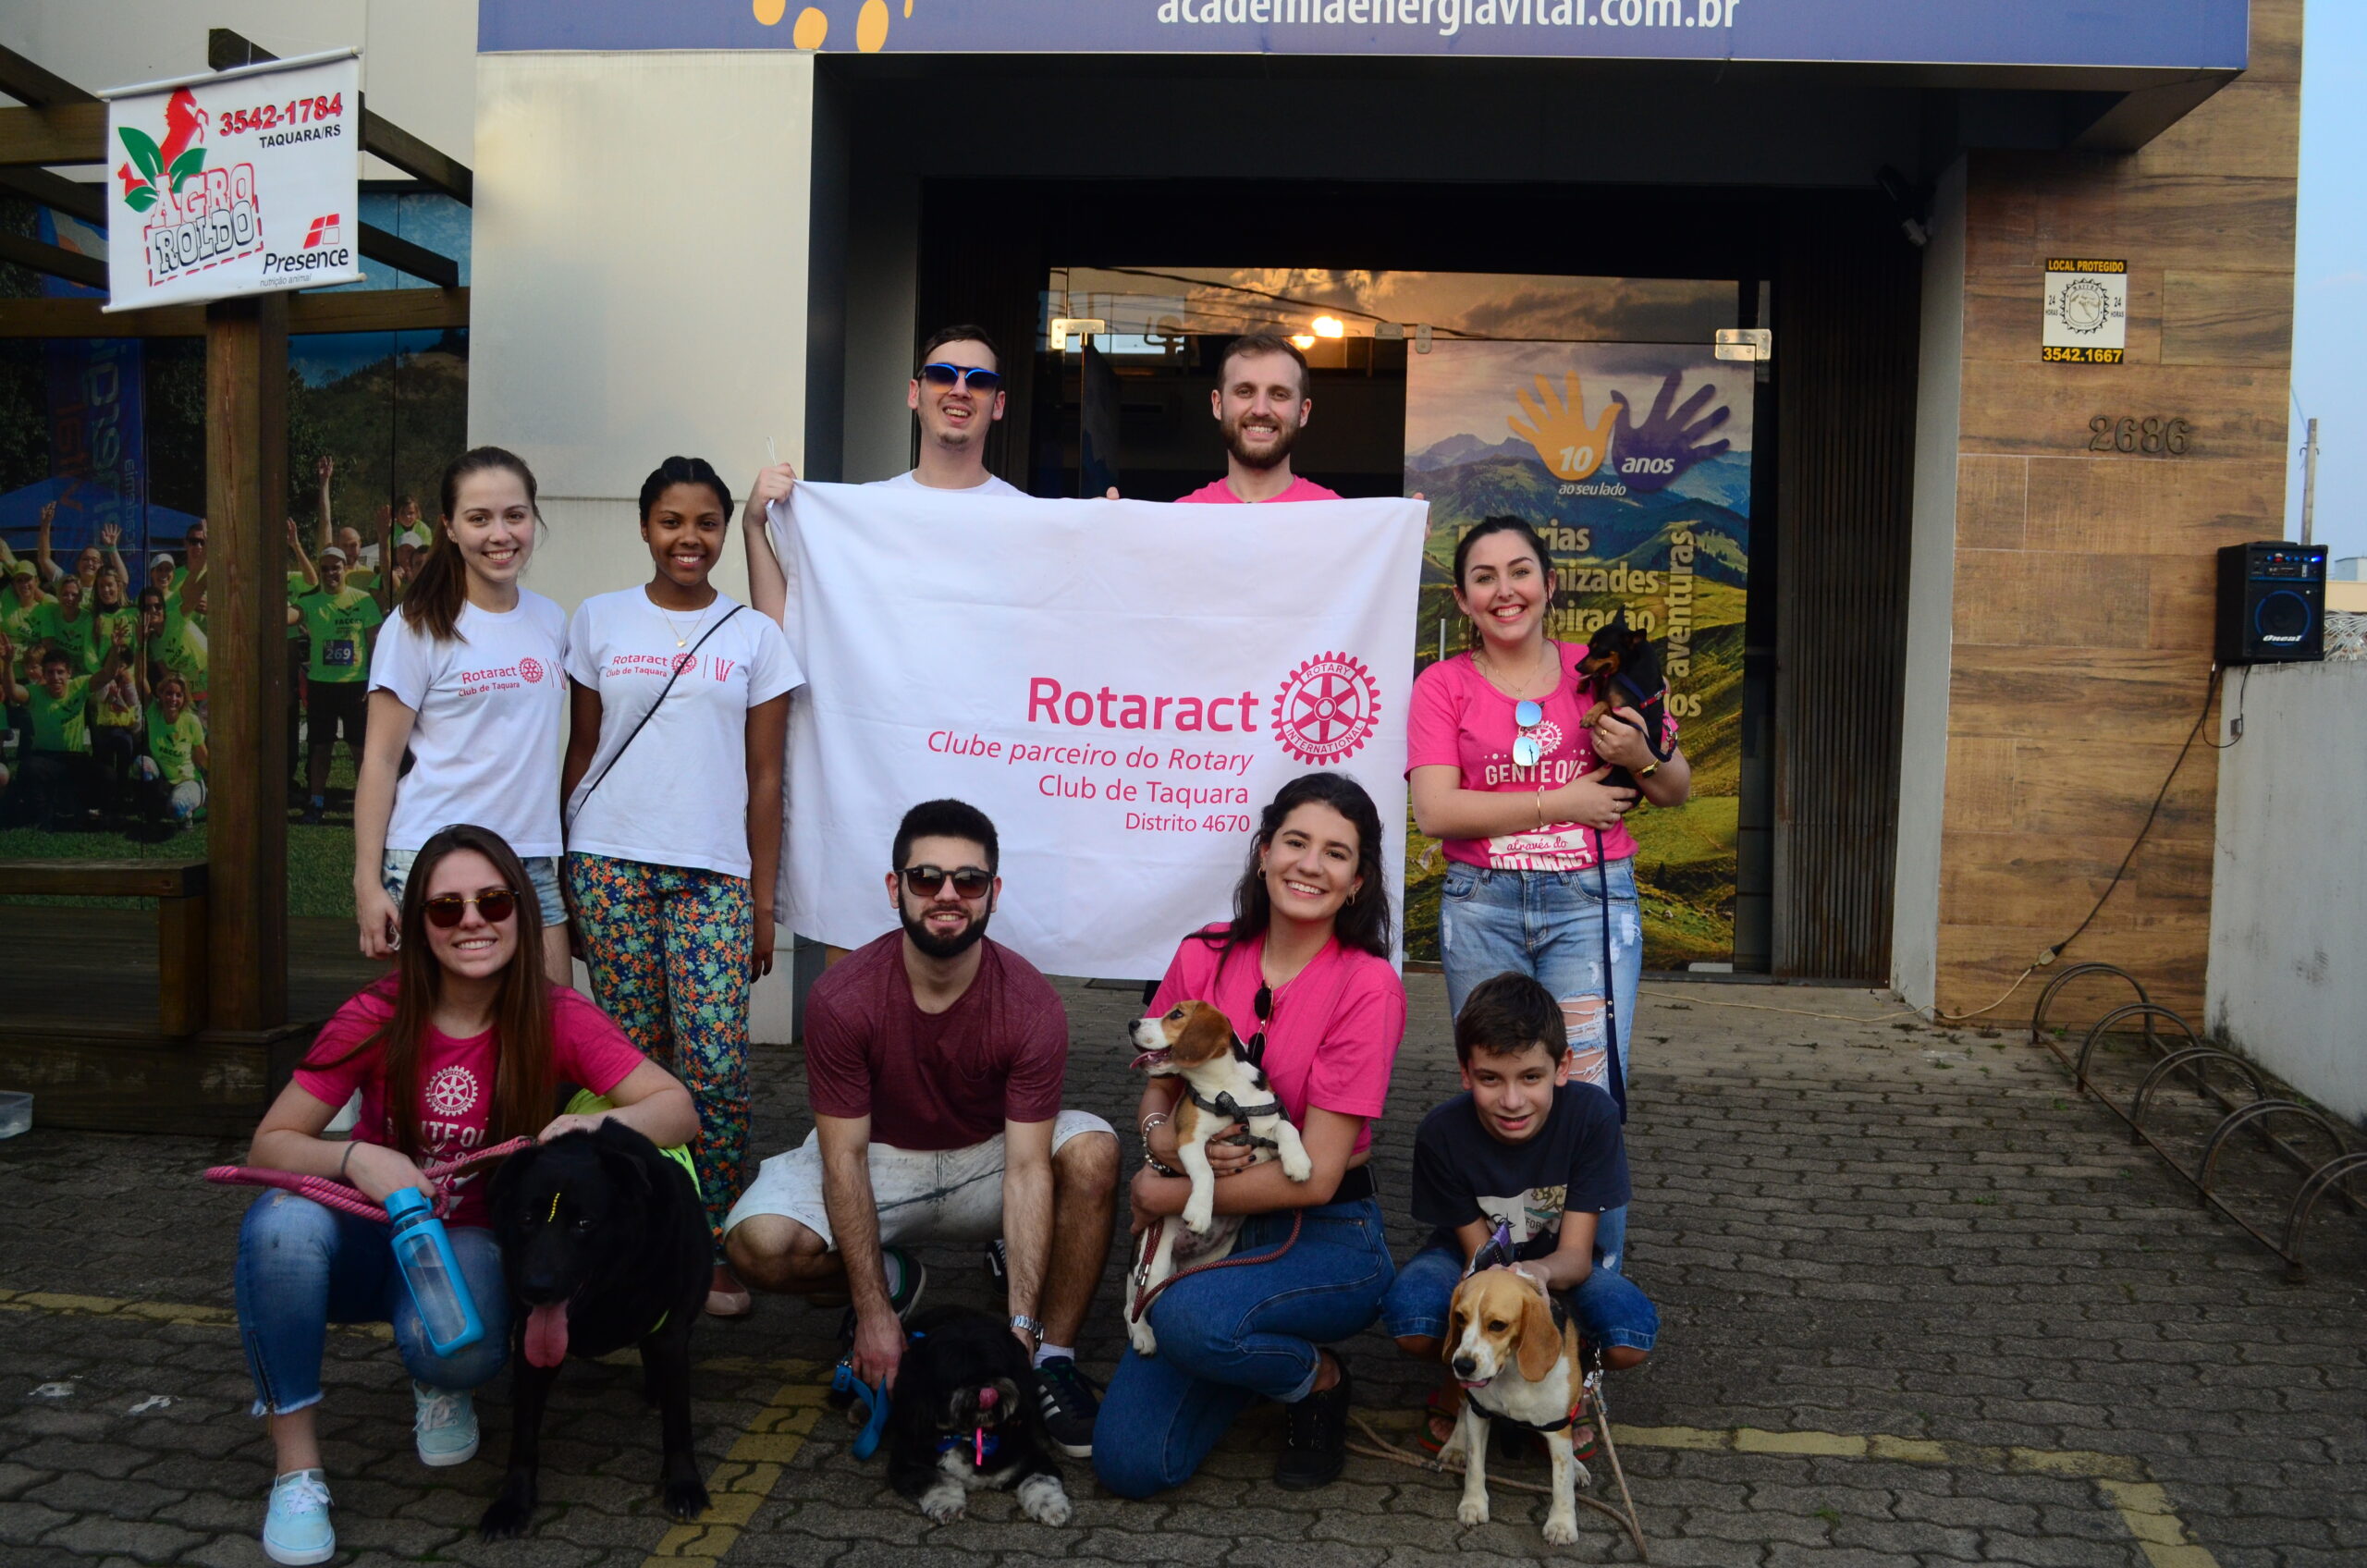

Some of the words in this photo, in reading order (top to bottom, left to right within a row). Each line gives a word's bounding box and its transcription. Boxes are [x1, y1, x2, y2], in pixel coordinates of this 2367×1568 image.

[219, 92, 343, 136] 3542-1784
[259, 124, 341, 149] TAQUARA/RS
[151, 163, 255, 229] AGRO
[154, 200, 254, 275] ROLDO
[263, 248, 349, 275] Presence
[2048, 260, 2075, 271] LOCAL
[2077, 260, 2124, 273] PROTEGIDO
[2048, 294, 2055, 305] 24
[2114, 297, 2122, 307] 24
[2043, 347, 2123, 362] 3542.1667
[2089, 415, 2190, 455] 2686
[1559, 446, 1593, 472] 10
[1621, 457, 1675, 474] anos
[1558, 484, 1574, 496] ao
[1575, 484, 1598, 496] seu
[1599, 482, 1626, 496] lado
[1665, 530, 1695, 678] aventuras
[325, 648, 351, 660] 269
[612, 654, 668, 667] Rotaract
[461, 666, 518, 684] Rotaract
[606, 668, 620, 678] Club
[622, 667, 632, 675] de
[634, 666, 668, 678] Taquara
[1306, 664, 1351, 679] ROTARY
[458, 687, 477, 697] Club
[479, 684, 490, 692] de
[492, 682, 521, 692] Taquara
[1026, 677, 1259, 733] Rotaract
[1286, 725, 1364, 753] INTERNATIONAL
[927, 730, 1001, 758] Clube
[1008, 740, 1117, 769] parceiro
[1125, 746, 1160, 769] do
[1167, 748, 1255, 778] Rotary
[1485, 760, 1553, 786] GENTE
[1037, 774, 1098, 801] Club
[1105, 778, 1137, 802] de
[1146, 780, 1249, 810] Taquara
[1124, 812, 1197, 833] Distrito
[1201, 814, 1251, 833] 4670
[1506, 836, 1551, 851] através
[1552, 836, 1568, 849] do
